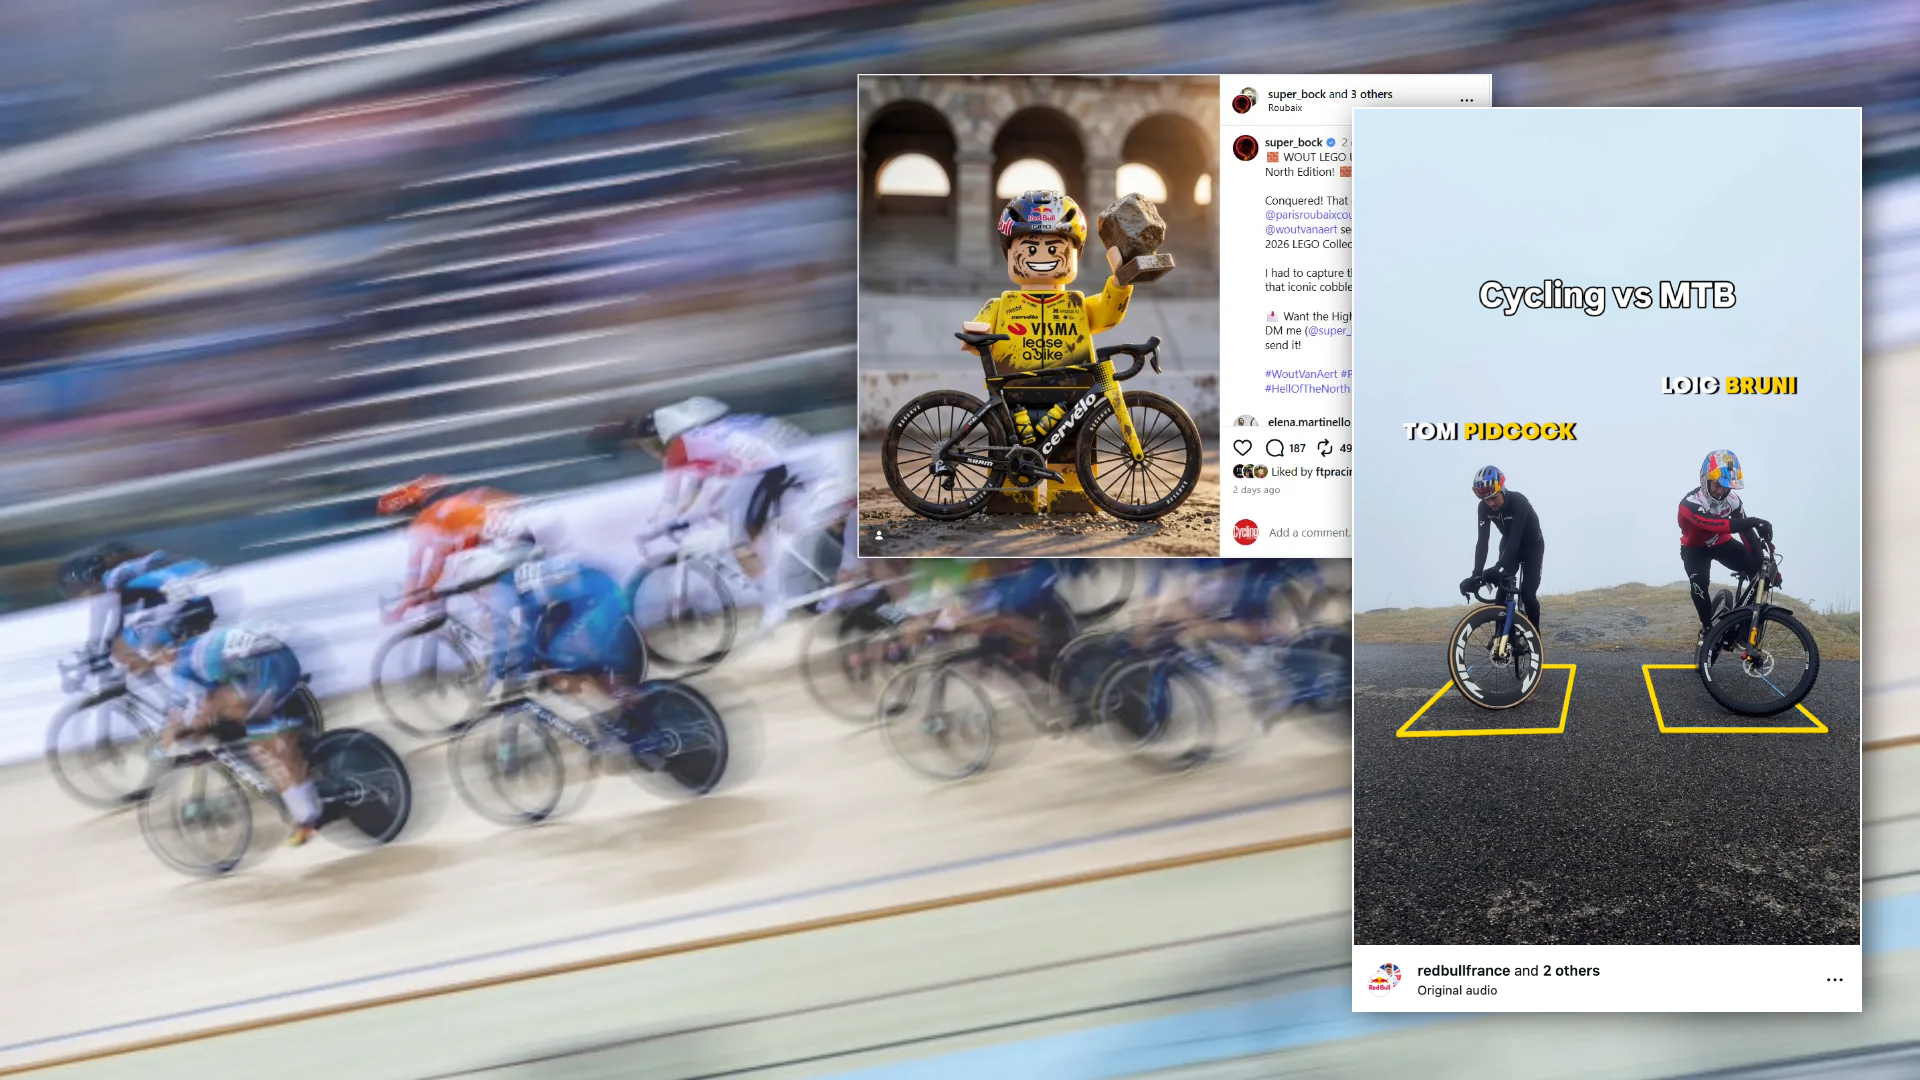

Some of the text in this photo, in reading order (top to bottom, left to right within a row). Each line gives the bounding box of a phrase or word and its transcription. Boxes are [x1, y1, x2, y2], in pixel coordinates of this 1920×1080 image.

[1031, 323, 1078, 335] VISMA
[1023, 337, 1063, 348] lease
[1042, 393, 1097, 455] cervélo
